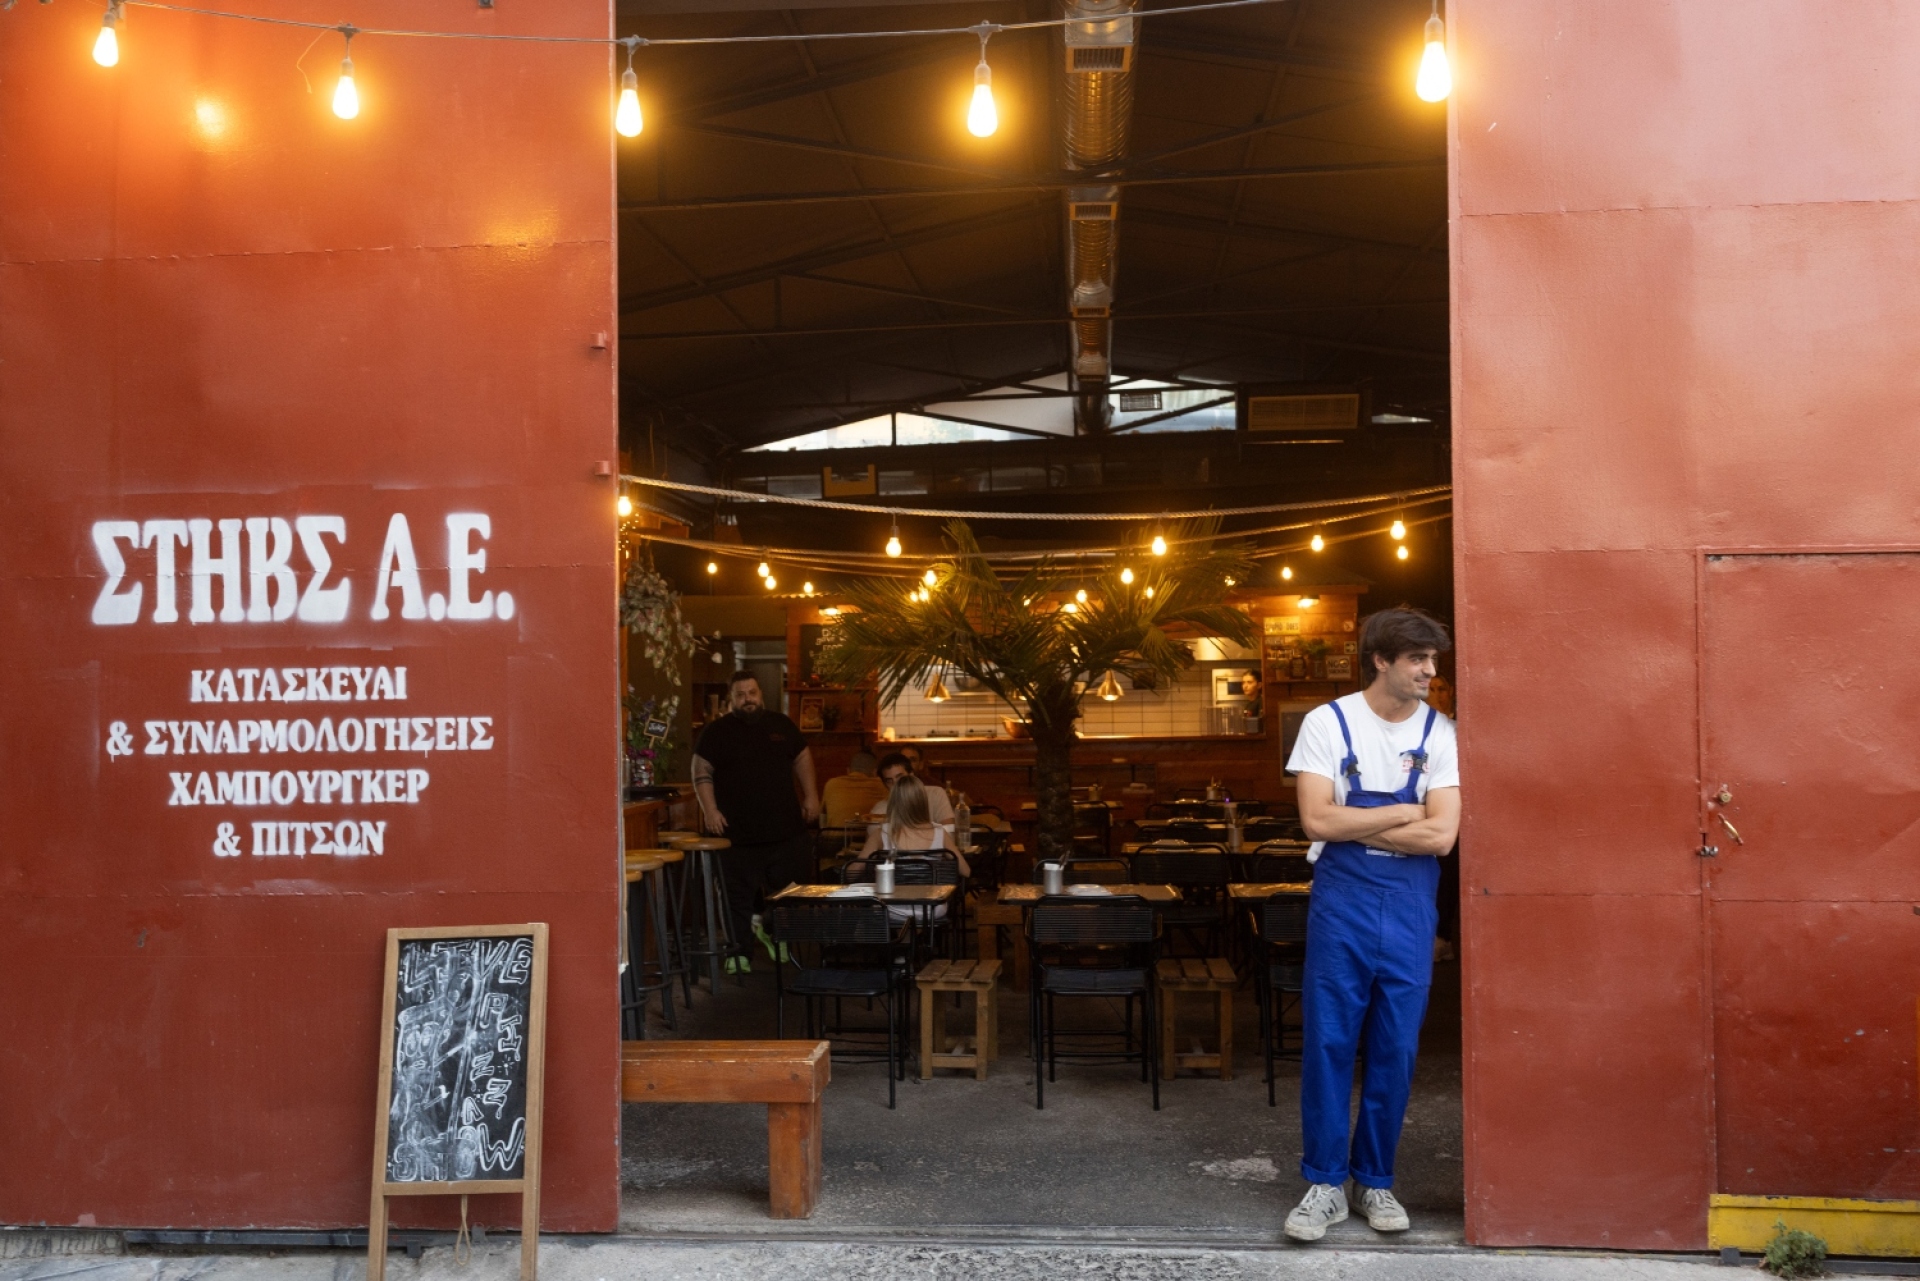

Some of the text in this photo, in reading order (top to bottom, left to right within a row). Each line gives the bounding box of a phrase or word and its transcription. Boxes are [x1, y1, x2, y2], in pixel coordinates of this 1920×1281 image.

[92, 513, 515, 625] ΣΤΗΒΣ Α.Ε.
[190, 667, 407, 703] ΚΑΤΑΣΚΕΥΑΙ
[106, 717, 494, 757] & ΣΥΝΑΡΜΟΛΟΓΗΣΕΙΣ
[169, 769, 429, 805] ΧΑΜΠΟΥΡΓΚΕΡ
[213, 821, 385, 857] & ΠΙΤΣΩΝ
[403, 938, 533, 992] LIVE
